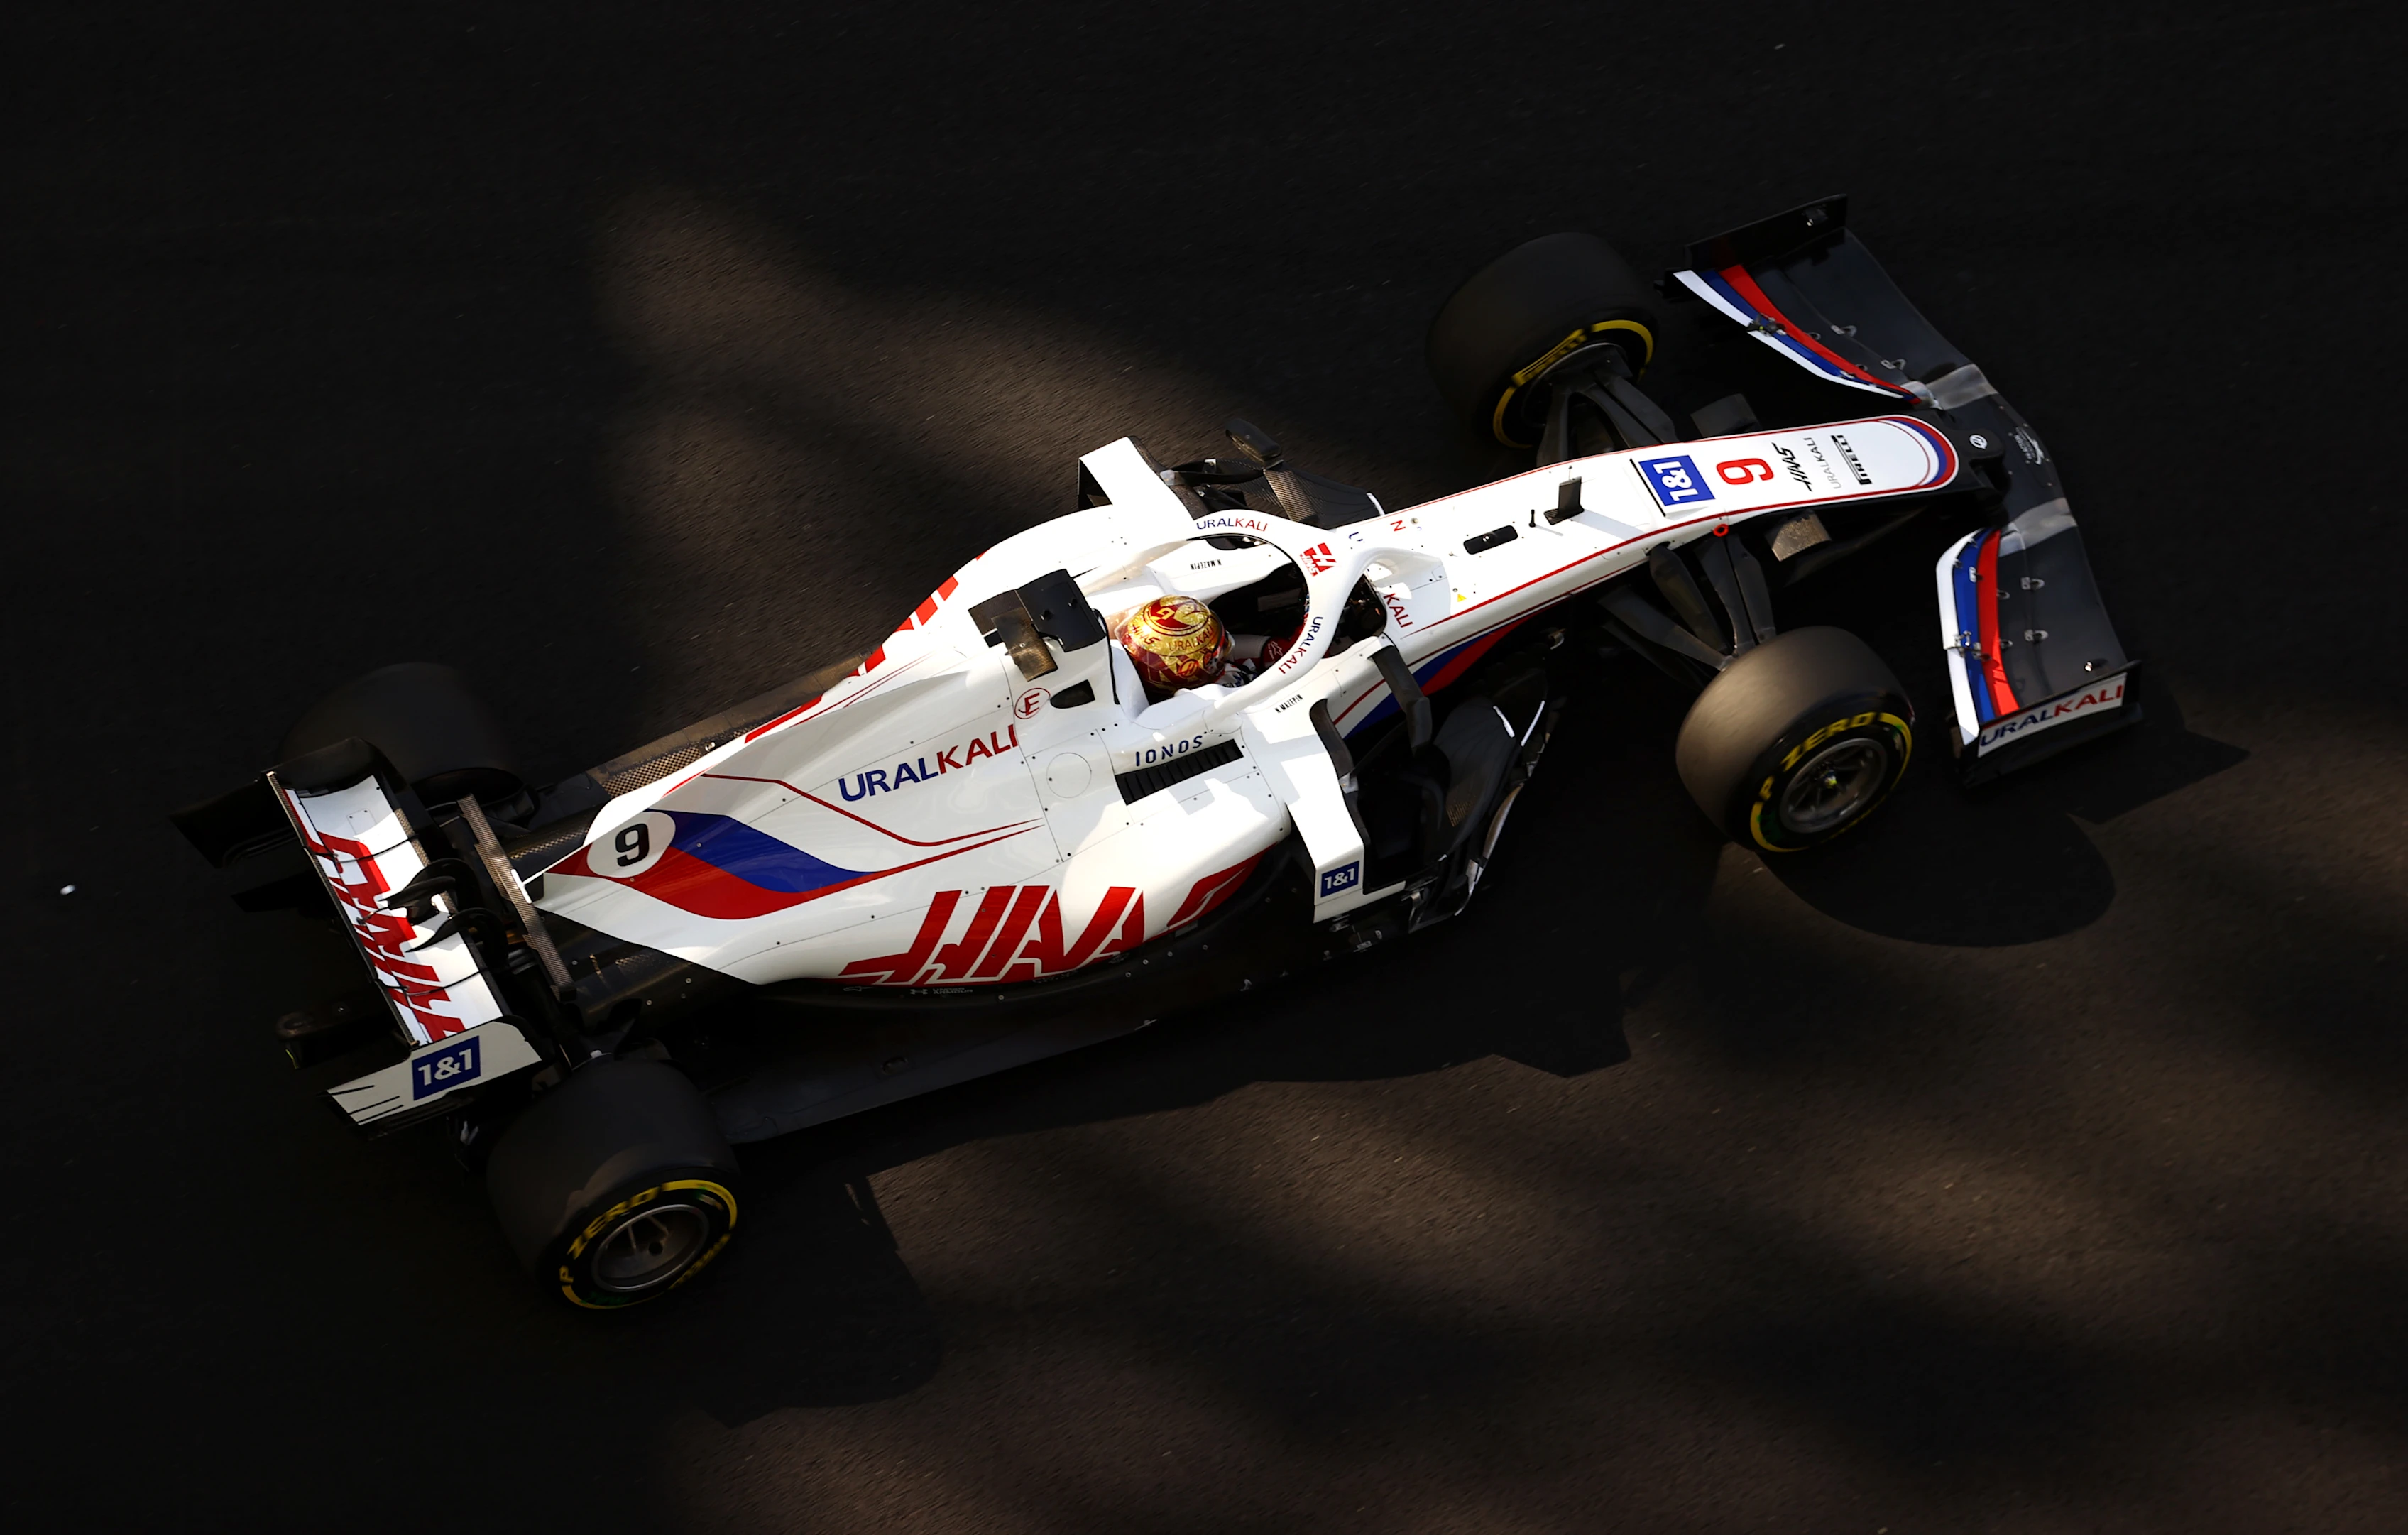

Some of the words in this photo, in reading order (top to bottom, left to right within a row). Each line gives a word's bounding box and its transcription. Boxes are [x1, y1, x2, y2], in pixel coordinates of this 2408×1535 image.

[1653, 461, 1699, 501] 1&1
[1803, 437, 1842, 489] URALKALI
[1831, 435, 1872, 485] PIRELLI
[1196, 518, 1268, 532] URALKALI
[1168, 624, 1213, 652] URALKALI
[1278, 616, 1323, 674] URALKALI
[1981, 684, 2123, 748] URALKALI
[838, 724, 1018, 802] URALKALI
[1135, 735, 1203, 767] IONOS
[1779, 711, 1877, 772] ZERO
[614, 822, 650, 868] 9
[1325, 869, 1356, 891] 1&1
[417, 1047, 474, 1087] 1&1
[566, 1186, 662, 1261] ZERO
